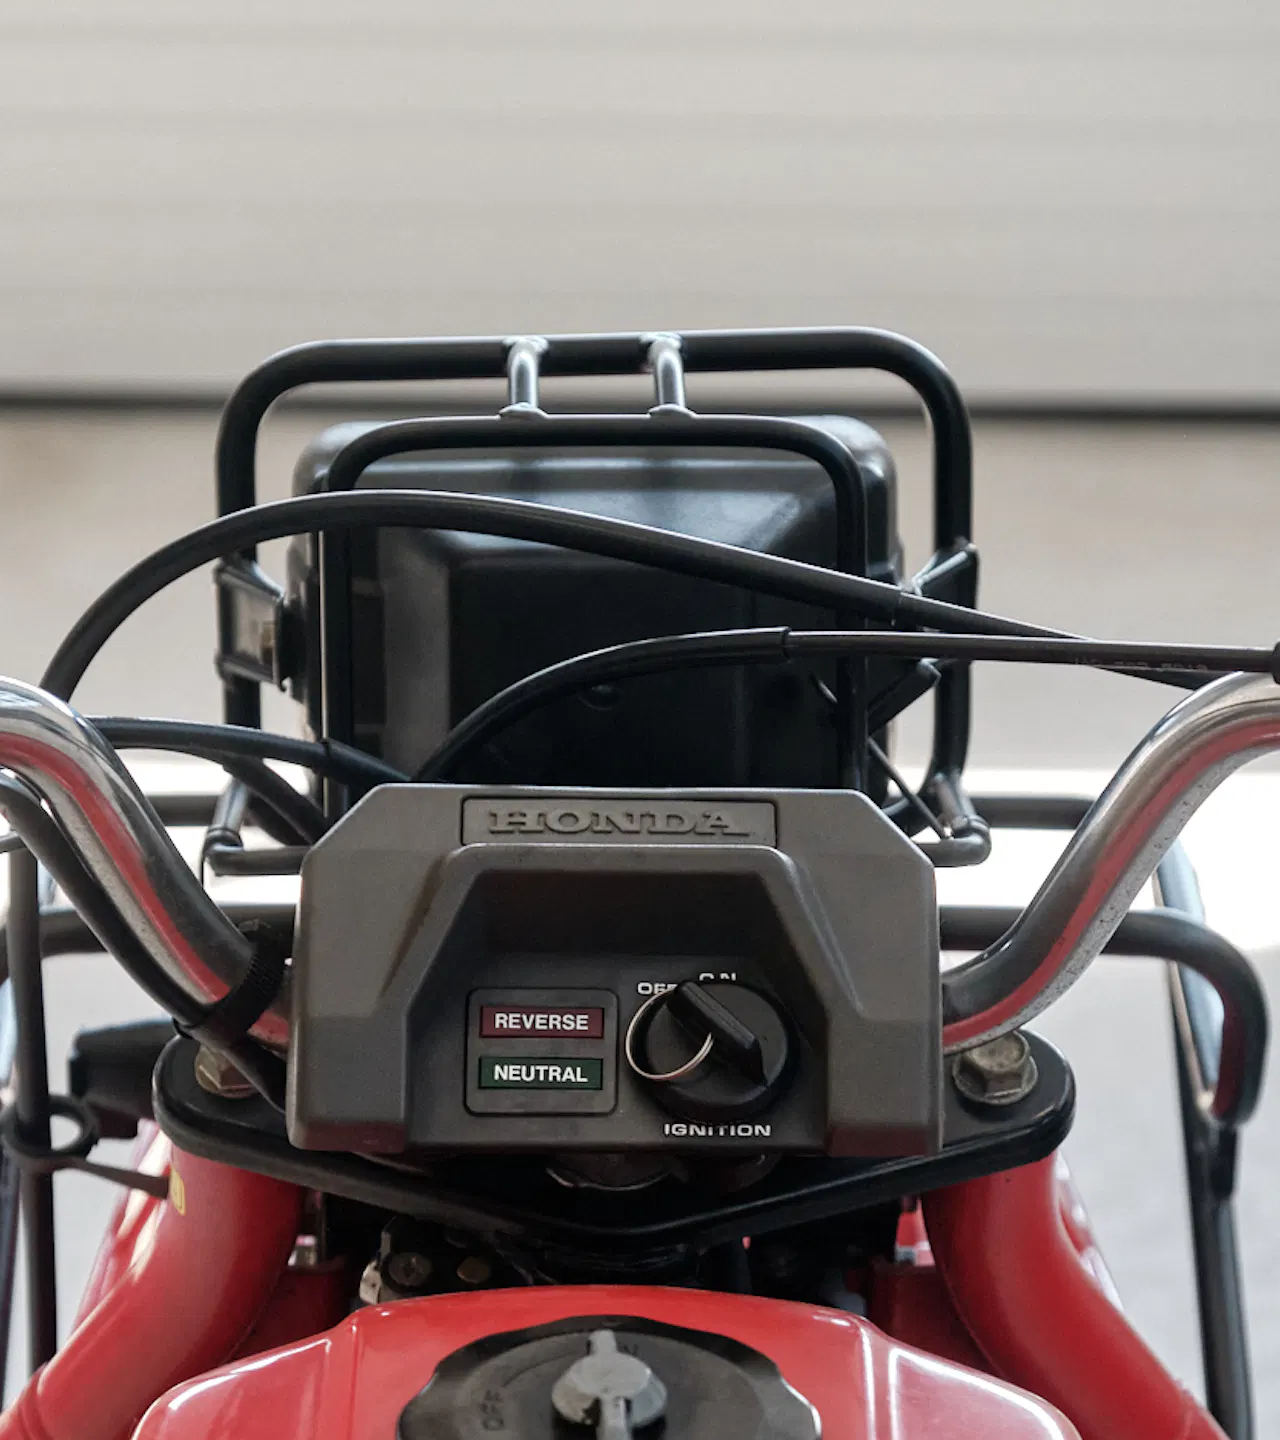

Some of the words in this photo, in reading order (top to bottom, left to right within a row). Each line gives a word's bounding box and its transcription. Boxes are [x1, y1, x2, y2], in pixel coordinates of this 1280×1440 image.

[488, 809, 750, 837] HONDA
[494, 1012, 589, 1031] REVERSE
[493, 1063, 589, 1083] NEUTRAL
[663, 1123, 771, 1137] IGNITION
